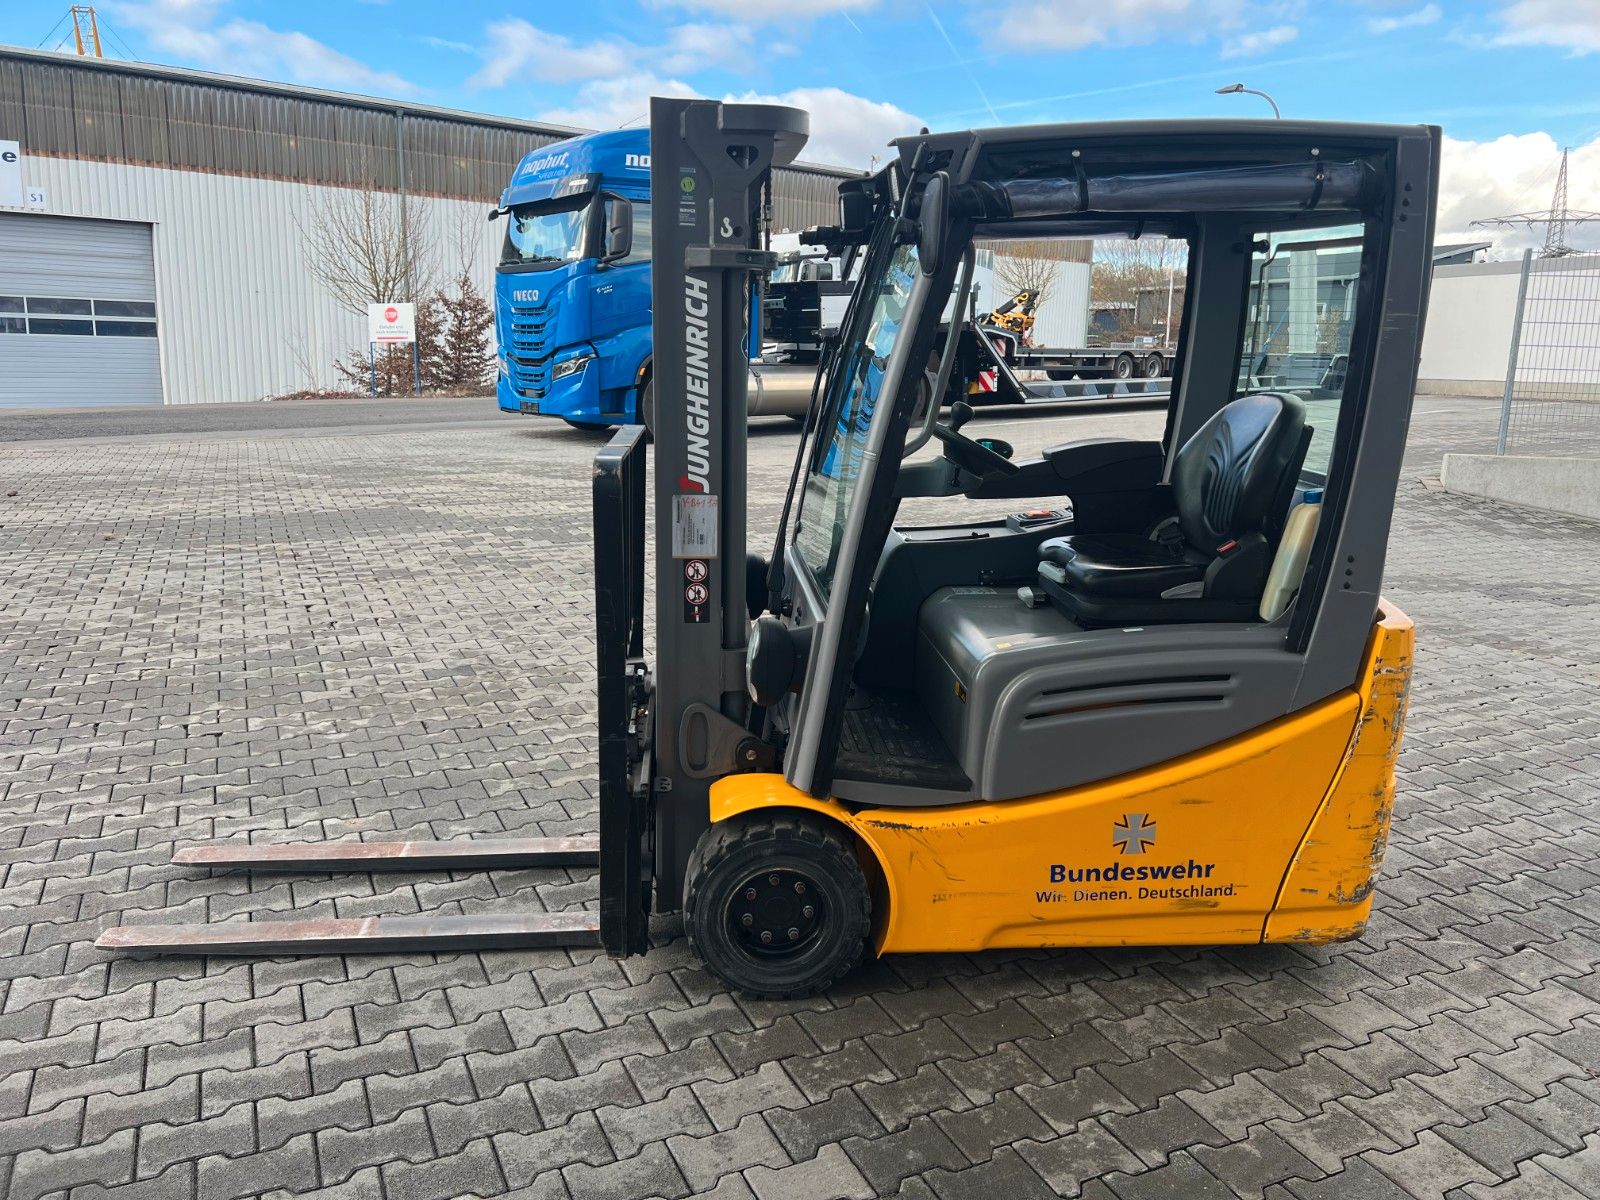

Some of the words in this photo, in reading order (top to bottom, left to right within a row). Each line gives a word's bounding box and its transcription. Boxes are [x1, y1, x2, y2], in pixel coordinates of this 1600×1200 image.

[31, 193, 43, 203] S1
[513, 289, 539, 302] IVECO
[685, 275, 710, 494] JUNGHEINRICH
[1050, 859, 1215, 883] Bundeswehr
[1074, 889, 1133, 902] Dienen.
[1138, 883, 1237, 900] Deutschland.
